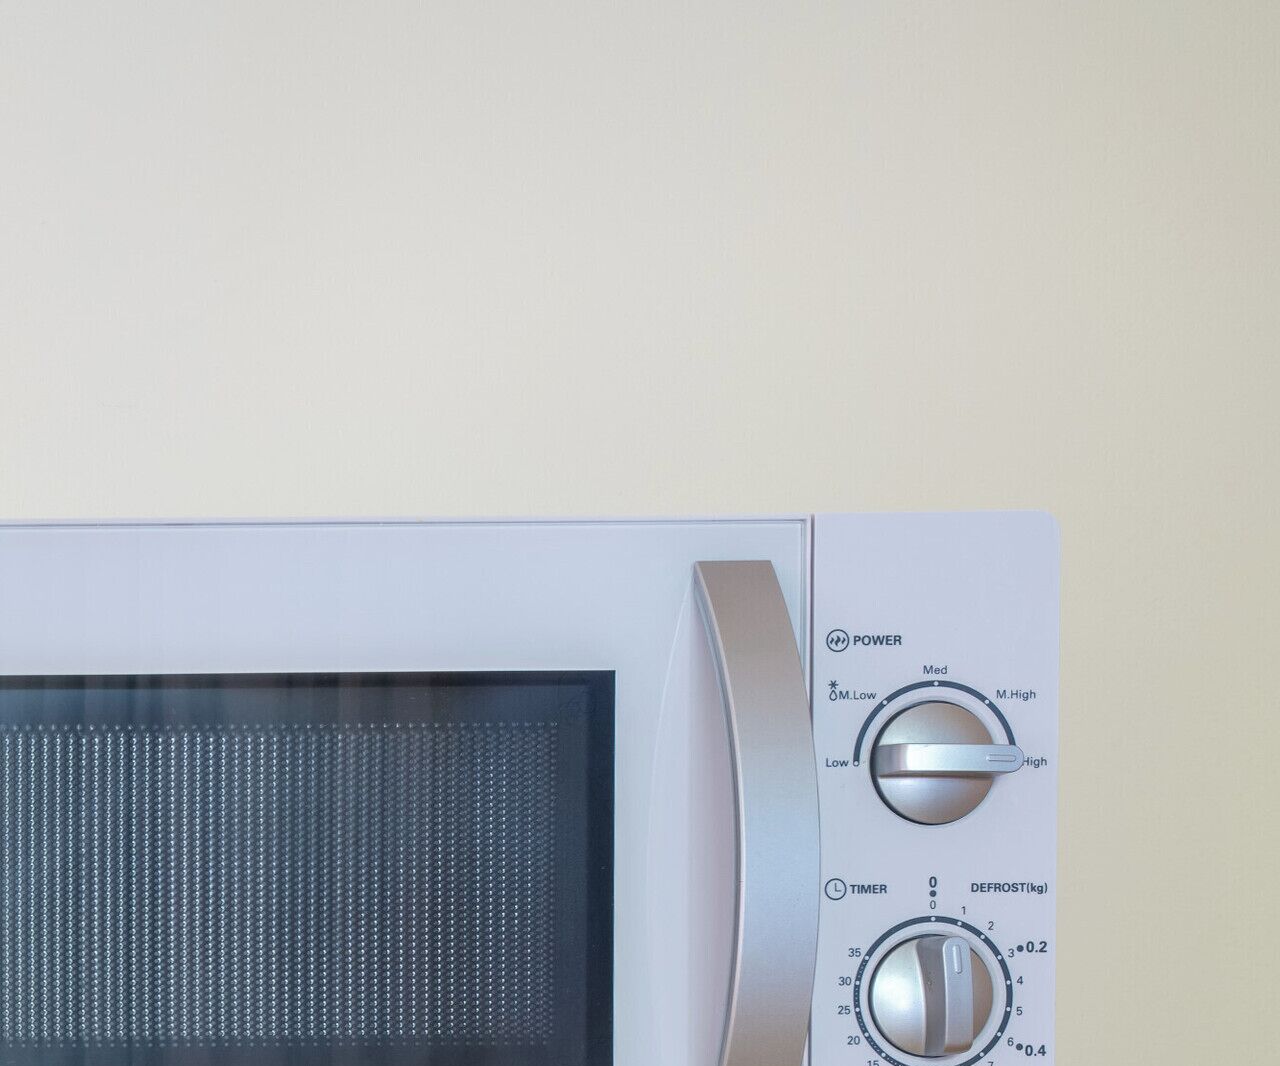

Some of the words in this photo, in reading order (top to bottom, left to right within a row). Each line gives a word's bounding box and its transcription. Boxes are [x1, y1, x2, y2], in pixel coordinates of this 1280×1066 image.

[853, 634, 902, 646] POWER
[923, 664, 948, 675] Med
[838, 690, 877, 700] M.Low
[996, 689, 1036, 702] M.High
[825, 758, 849, 768] Low
[928, 876, 938, 889] 0
[849, 884, 888, 895] TIMER
[970, 882, 1048, 895] DEFROST(kg)
[929, 899, 937, 910] 0
[961, 905, 966, 915] 1
[987, 920, 995, 931] 2
[1025, 940, 1048, 953] 0.2
[847, 947, 862, 958] 35
[1007, 947, 1015, 959] 3
[838, 976, 852, 987] 30
[1016, 975, 1024, 985] 4
[837, 1005, 851, 1016] 25
[1016, 1006, 1023, 1016] 5
[847, 1035, 861, 1046] 20
[1007, 1036, 1015, 1047] 6
[1024, 1044, 1047, 1057] 0.4
